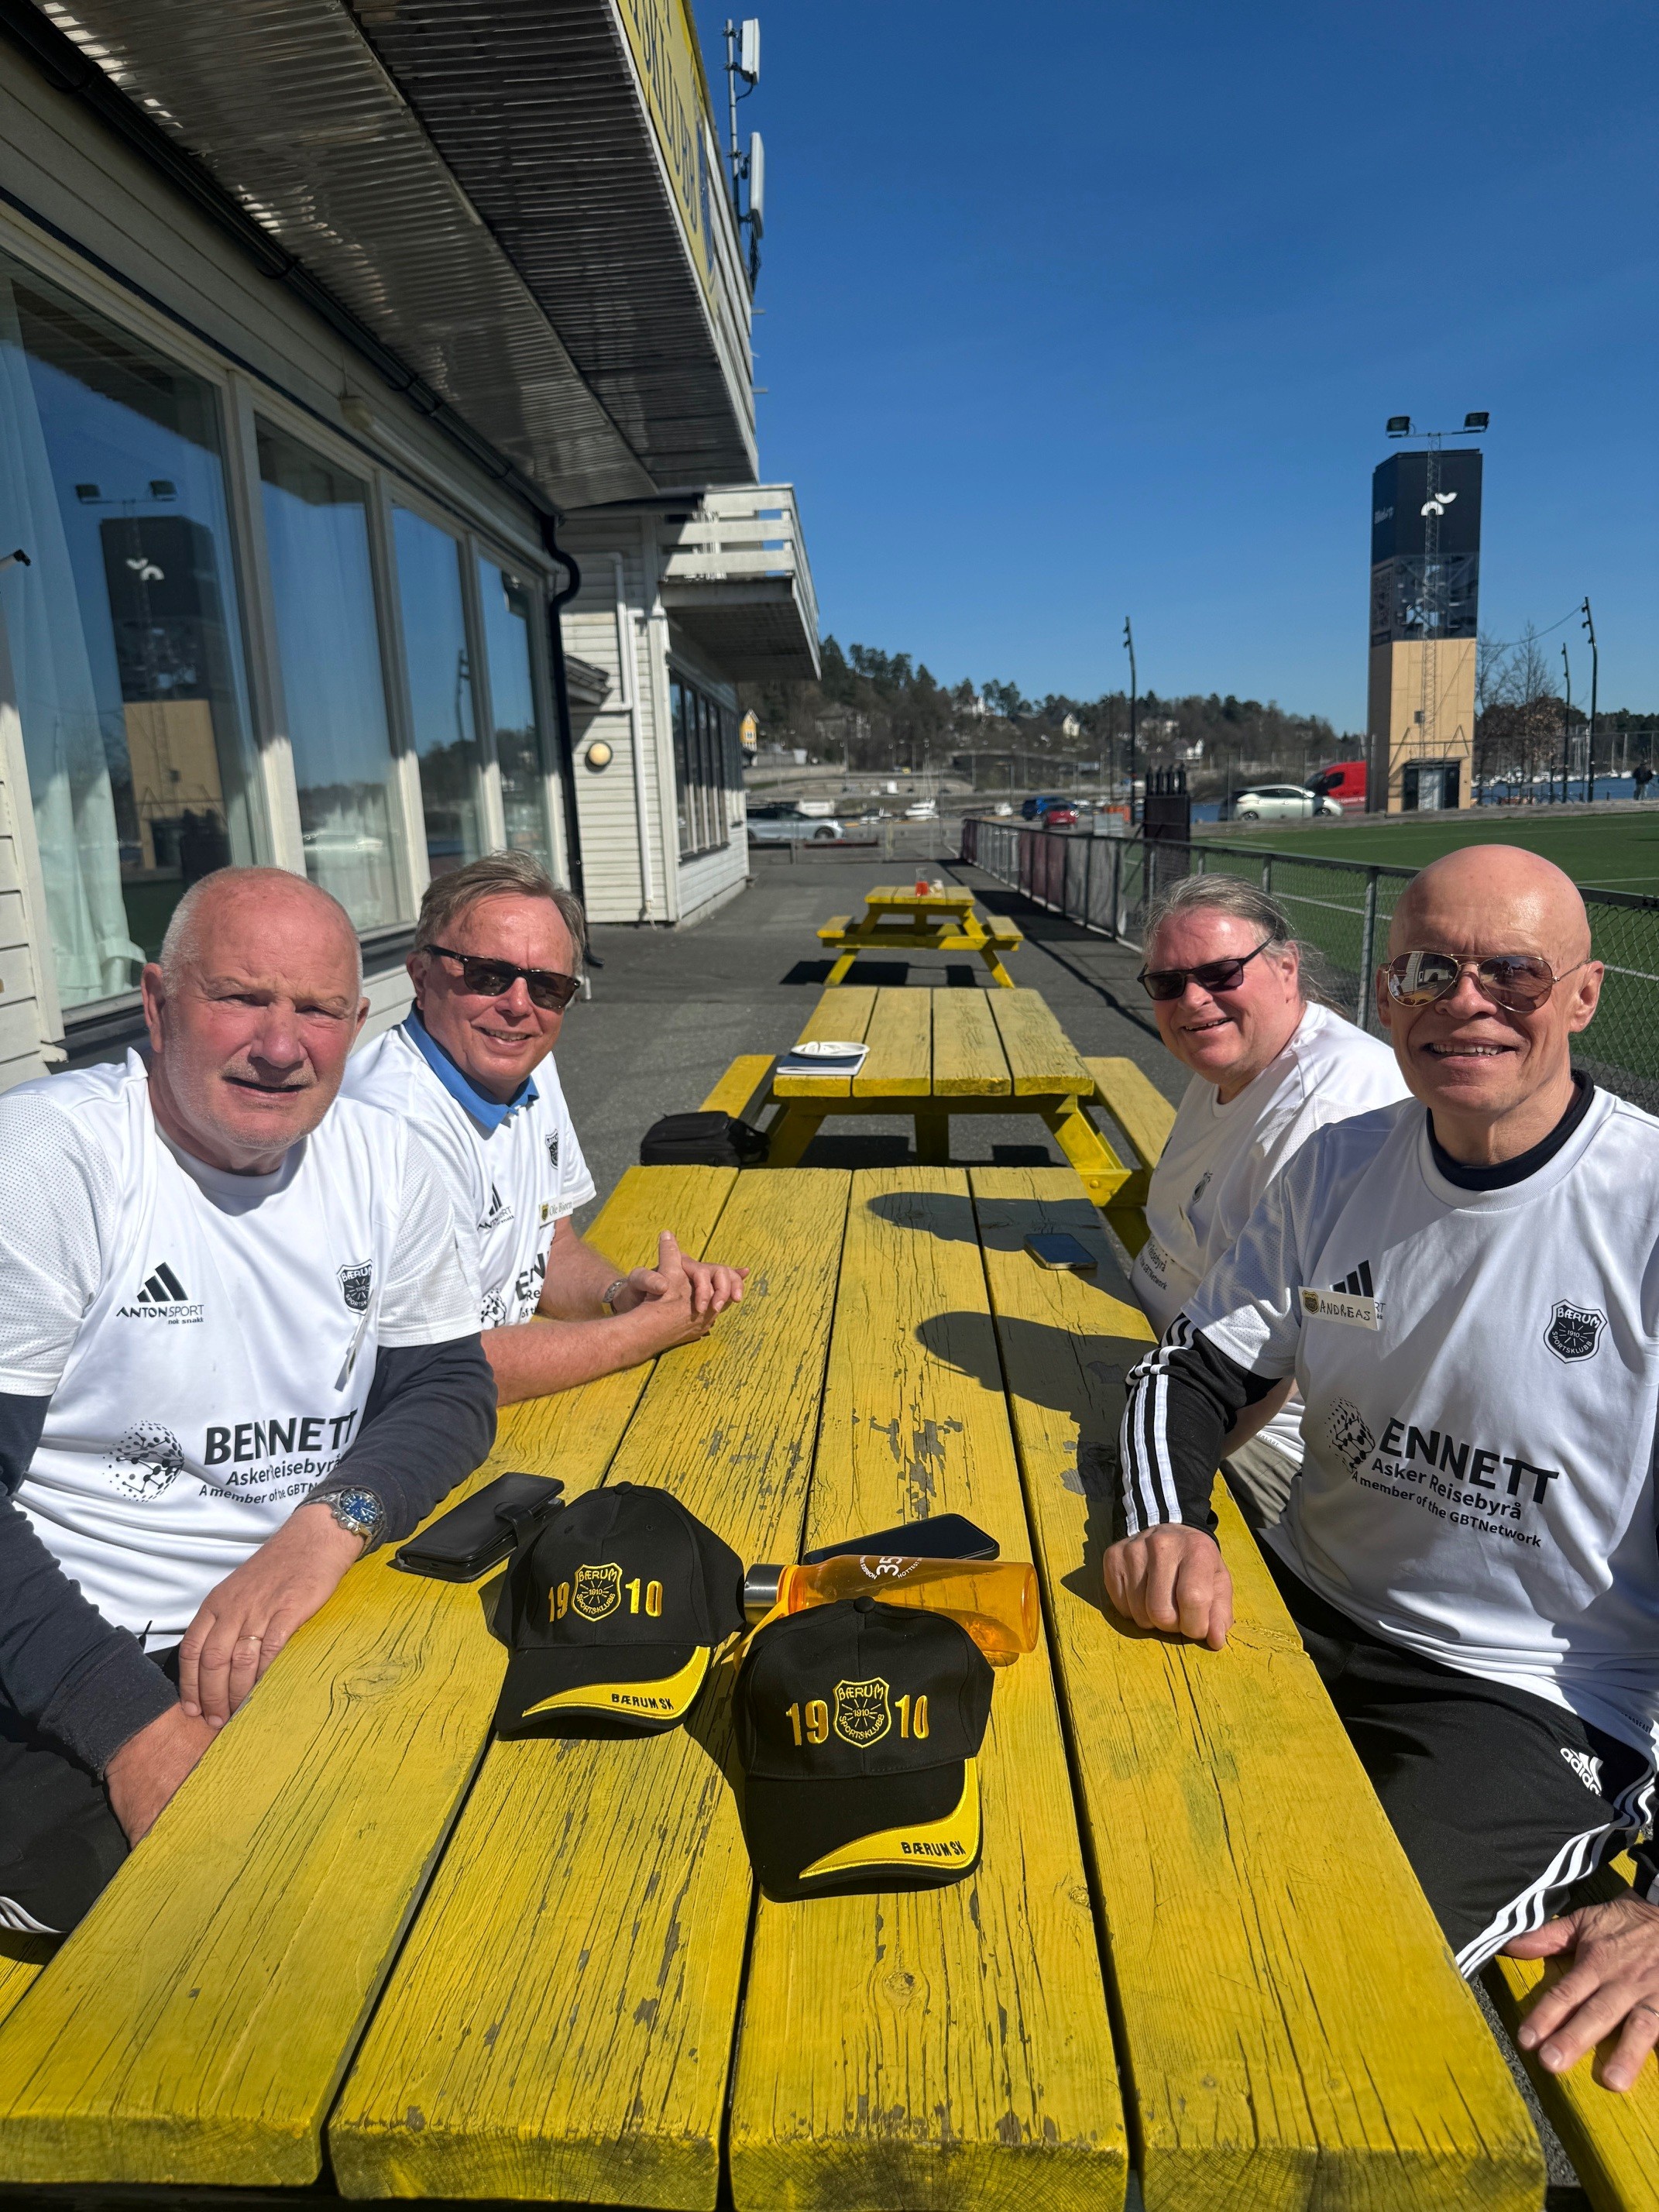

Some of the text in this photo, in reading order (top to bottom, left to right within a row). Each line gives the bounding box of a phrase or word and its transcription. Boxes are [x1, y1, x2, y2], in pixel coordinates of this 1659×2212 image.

[345, 1293, 369, 1307] SPORTSK
[116, 1305, 204, 1318] ANTONSPORT
[1319, 1300, 1370, 1321] ANDREAS
[1557, 1307, 1600, 1328] BÆRUM
[1552, 1331, 1592, 1354] SPORTSKLUBB
[204, 1408, 358, 1465] BENNETT
[1379, 1417, 1559, 1504] ENNETT
[226, 1467, 270, 1486] Asker
[199, 1485, 208, 1496] A
[210, 1488, 266, 1504] member
[1372, 1458, 1522, 1520] Asker Reisebyrå
[1352, 1471, 1541, 1547] A member of the GBTNetwork
[579, 1568, 617, 1582] BÆRUM
[860, 1564, 878, 1580] NORGES
[898, 1561, 919, 1578] HOTTEST
[548, 1578, 663, 1623] 19 10
[589, 1588, 603, 1596] 1910
[611, 1693, 674, 1710] BÆRUM SK
[838, 1684, 884, 1701] BÆRUM
[785, 1695, 929, 1746] 19 10
[852, 1709, 870, 1717] 1910
[1560, 1748, 1601, 1796] adida
[901, 1841, 966, 1856] BÆRUM SK
